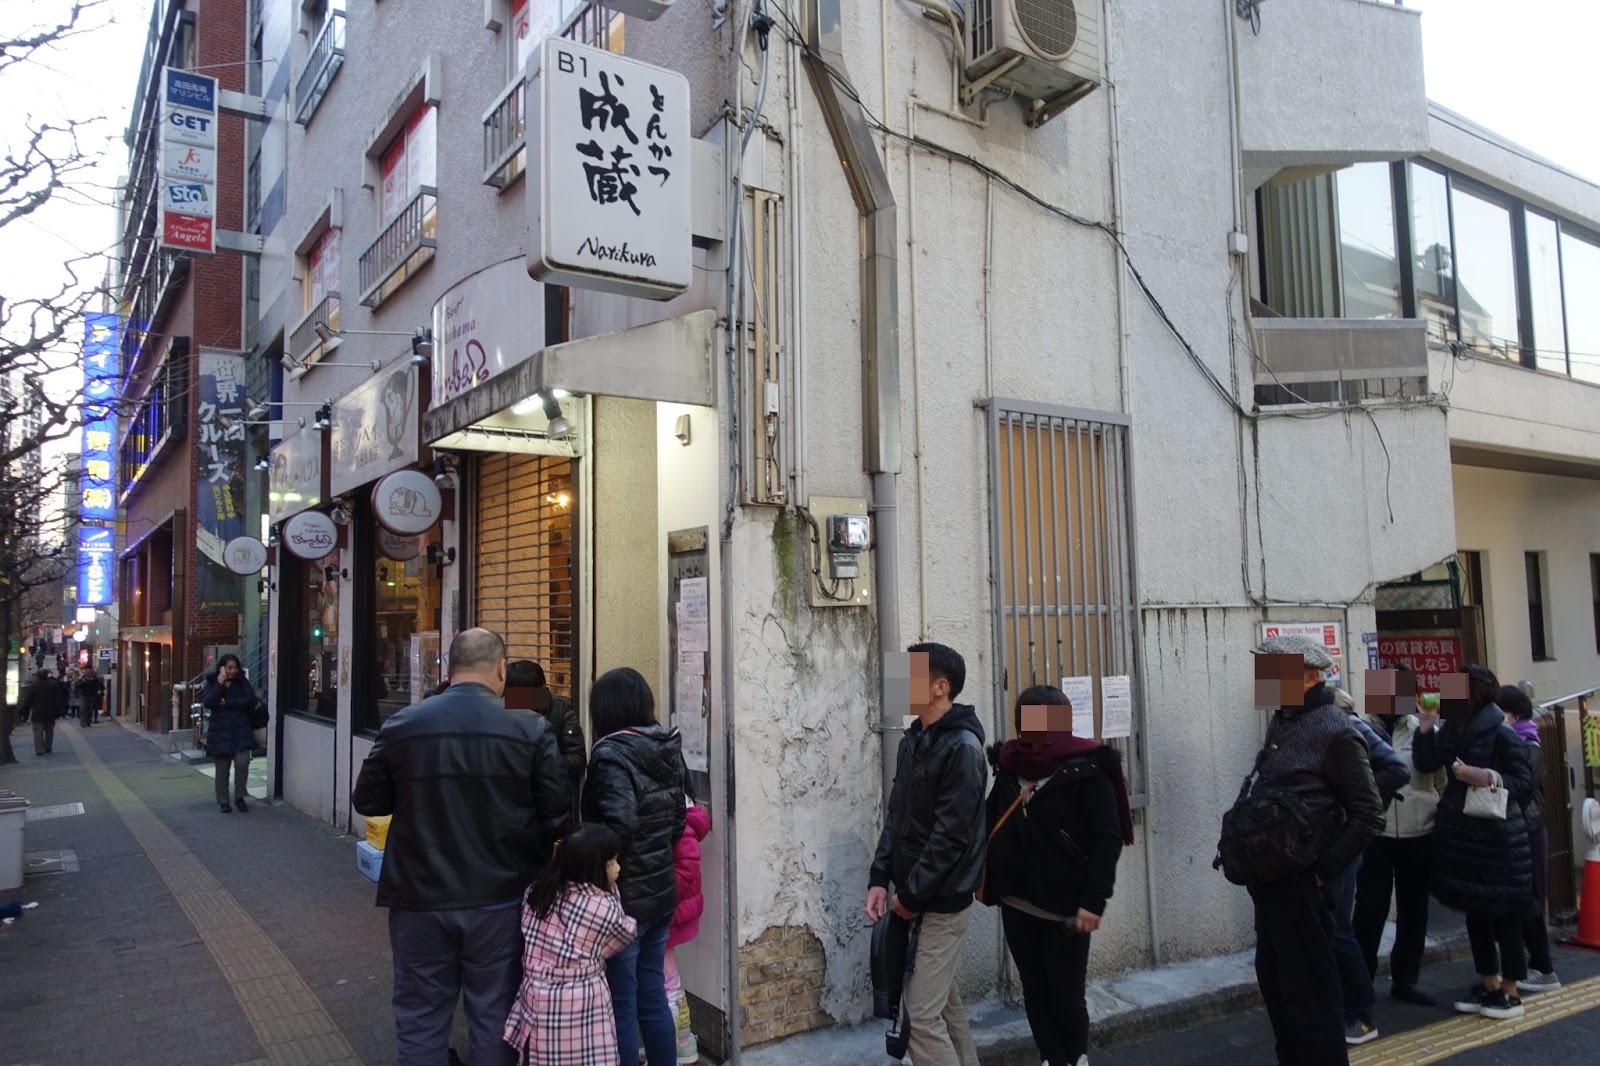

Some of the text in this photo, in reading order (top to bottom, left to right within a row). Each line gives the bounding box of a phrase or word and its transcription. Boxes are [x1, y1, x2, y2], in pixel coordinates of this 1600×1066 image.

[558, 50, 588, 78] B1
[170, 86, 212, 103] マリンビル
[173, 79, 208, 95] 高田馬場
[169, 112, 212, 133] GET
[575, 70, 640, 217] 成蔵
[646, 84, 672, 188] とんかつ
[171, 230, 207, 243] Angelo
[576, 236, 657, 268] Narikura
[198, 401, 230, 484] クルーズ
[1282, 626, 1320, 635] frontier home
